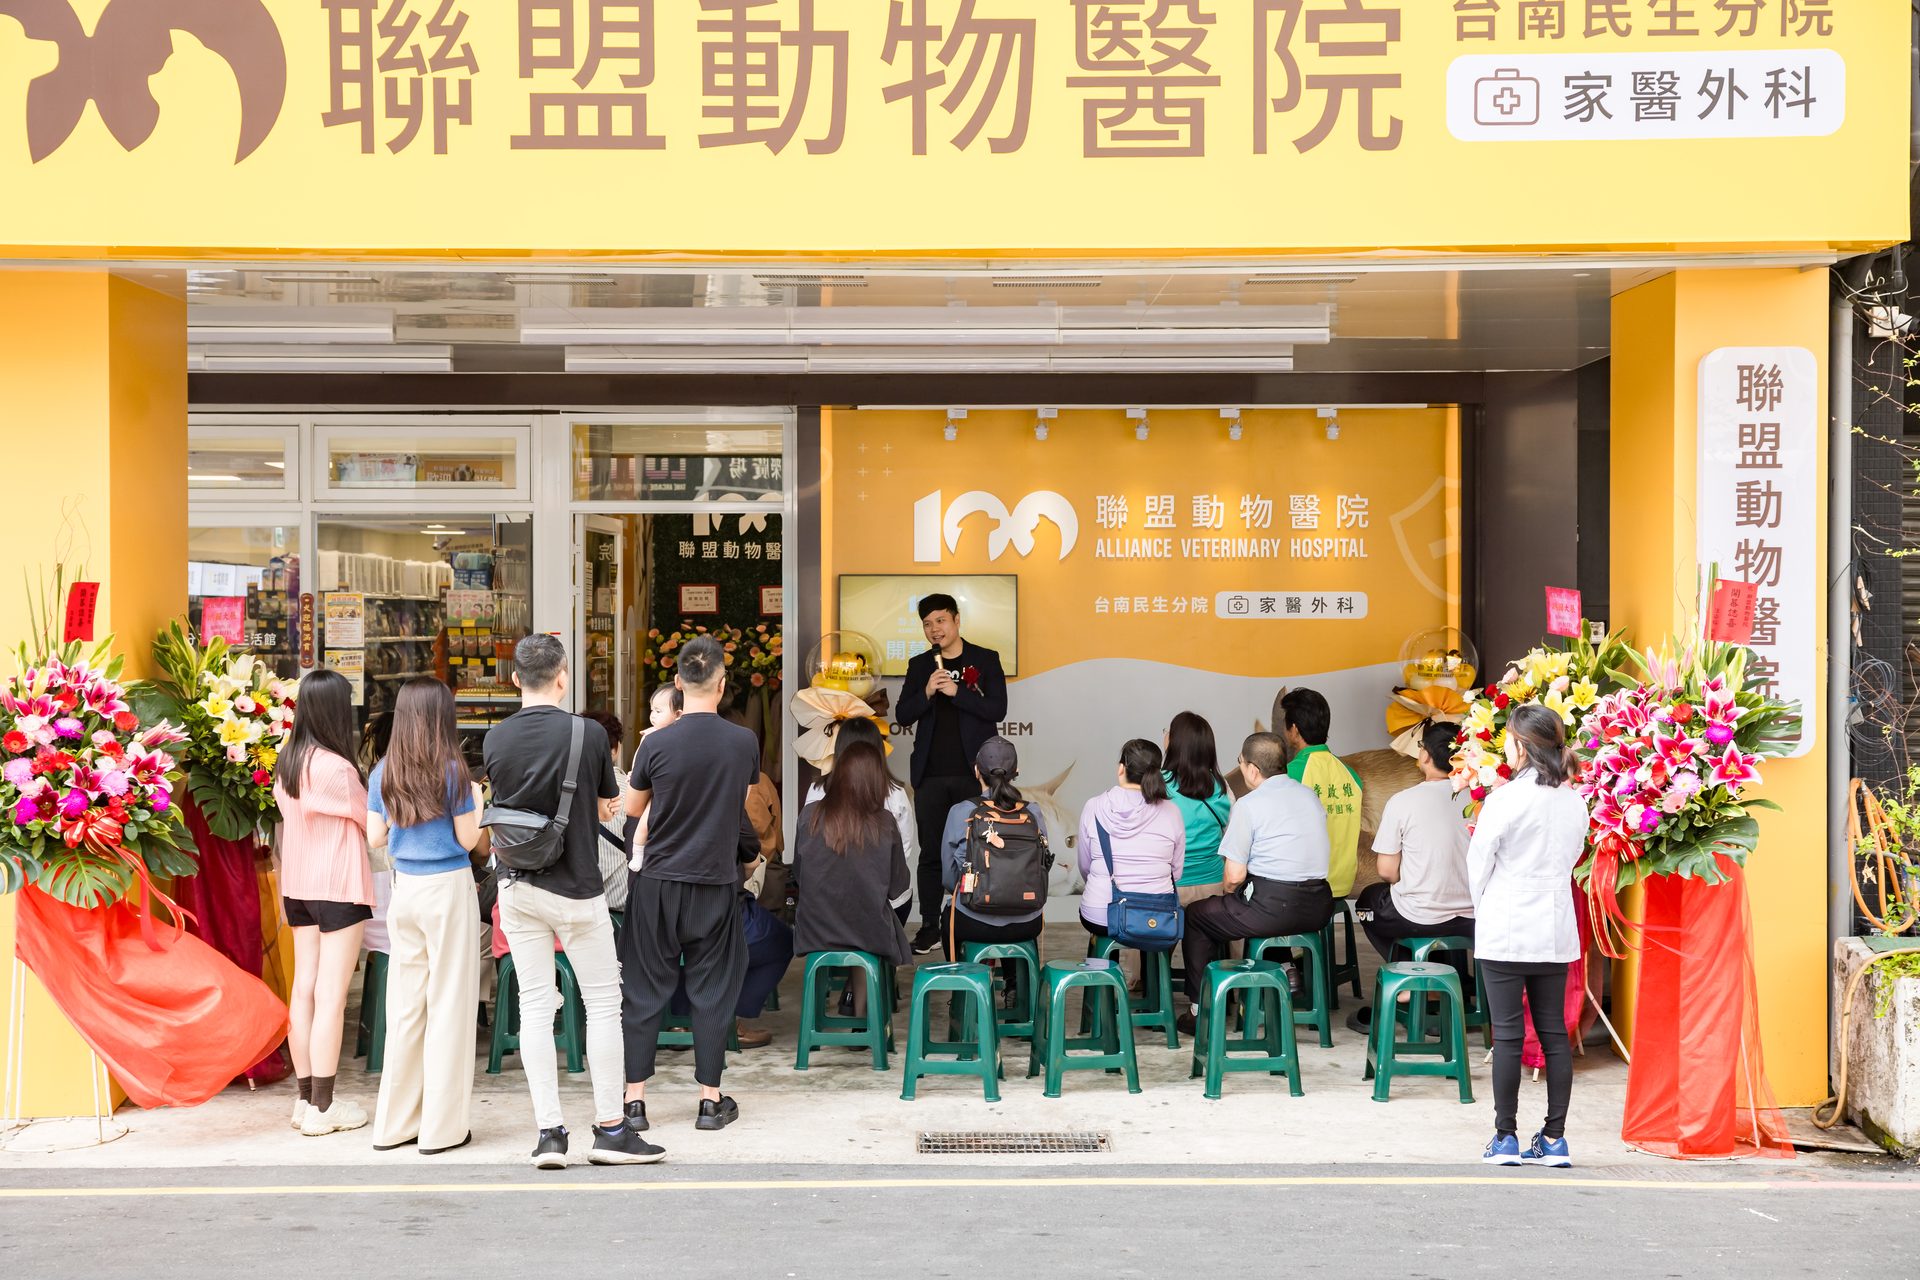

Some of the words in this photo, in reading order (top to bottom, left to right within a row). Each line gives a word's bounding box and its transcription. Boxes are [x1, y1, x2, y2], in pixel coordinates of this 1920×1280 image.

[1453, 0, 1834, 42] 台南民生分院
[321, 0, 1403, 158] 聯盟動物醫院
[1563, 65, 1817, 123] 家醫外科
[1096, 495, 1369, 529] 聯盟動物醫院
[1733, 363, 1784, 698] 聯盟動物醫院
[679, 540, 783, 560] 聯盟動物醫
[1096, 538, 1172, 558] ALLIANCE
[1181, 538, 1281, 558] VETERINARY
[1291, 538, 1368, 558] HOSPITAL
[1094, 595, 1208, 614] 台南民生分院
[1259, 596, 1354, 614] 家醫外科
[888, 721, 914, 736] OR
[997, 721, 1033, 736] HEM
